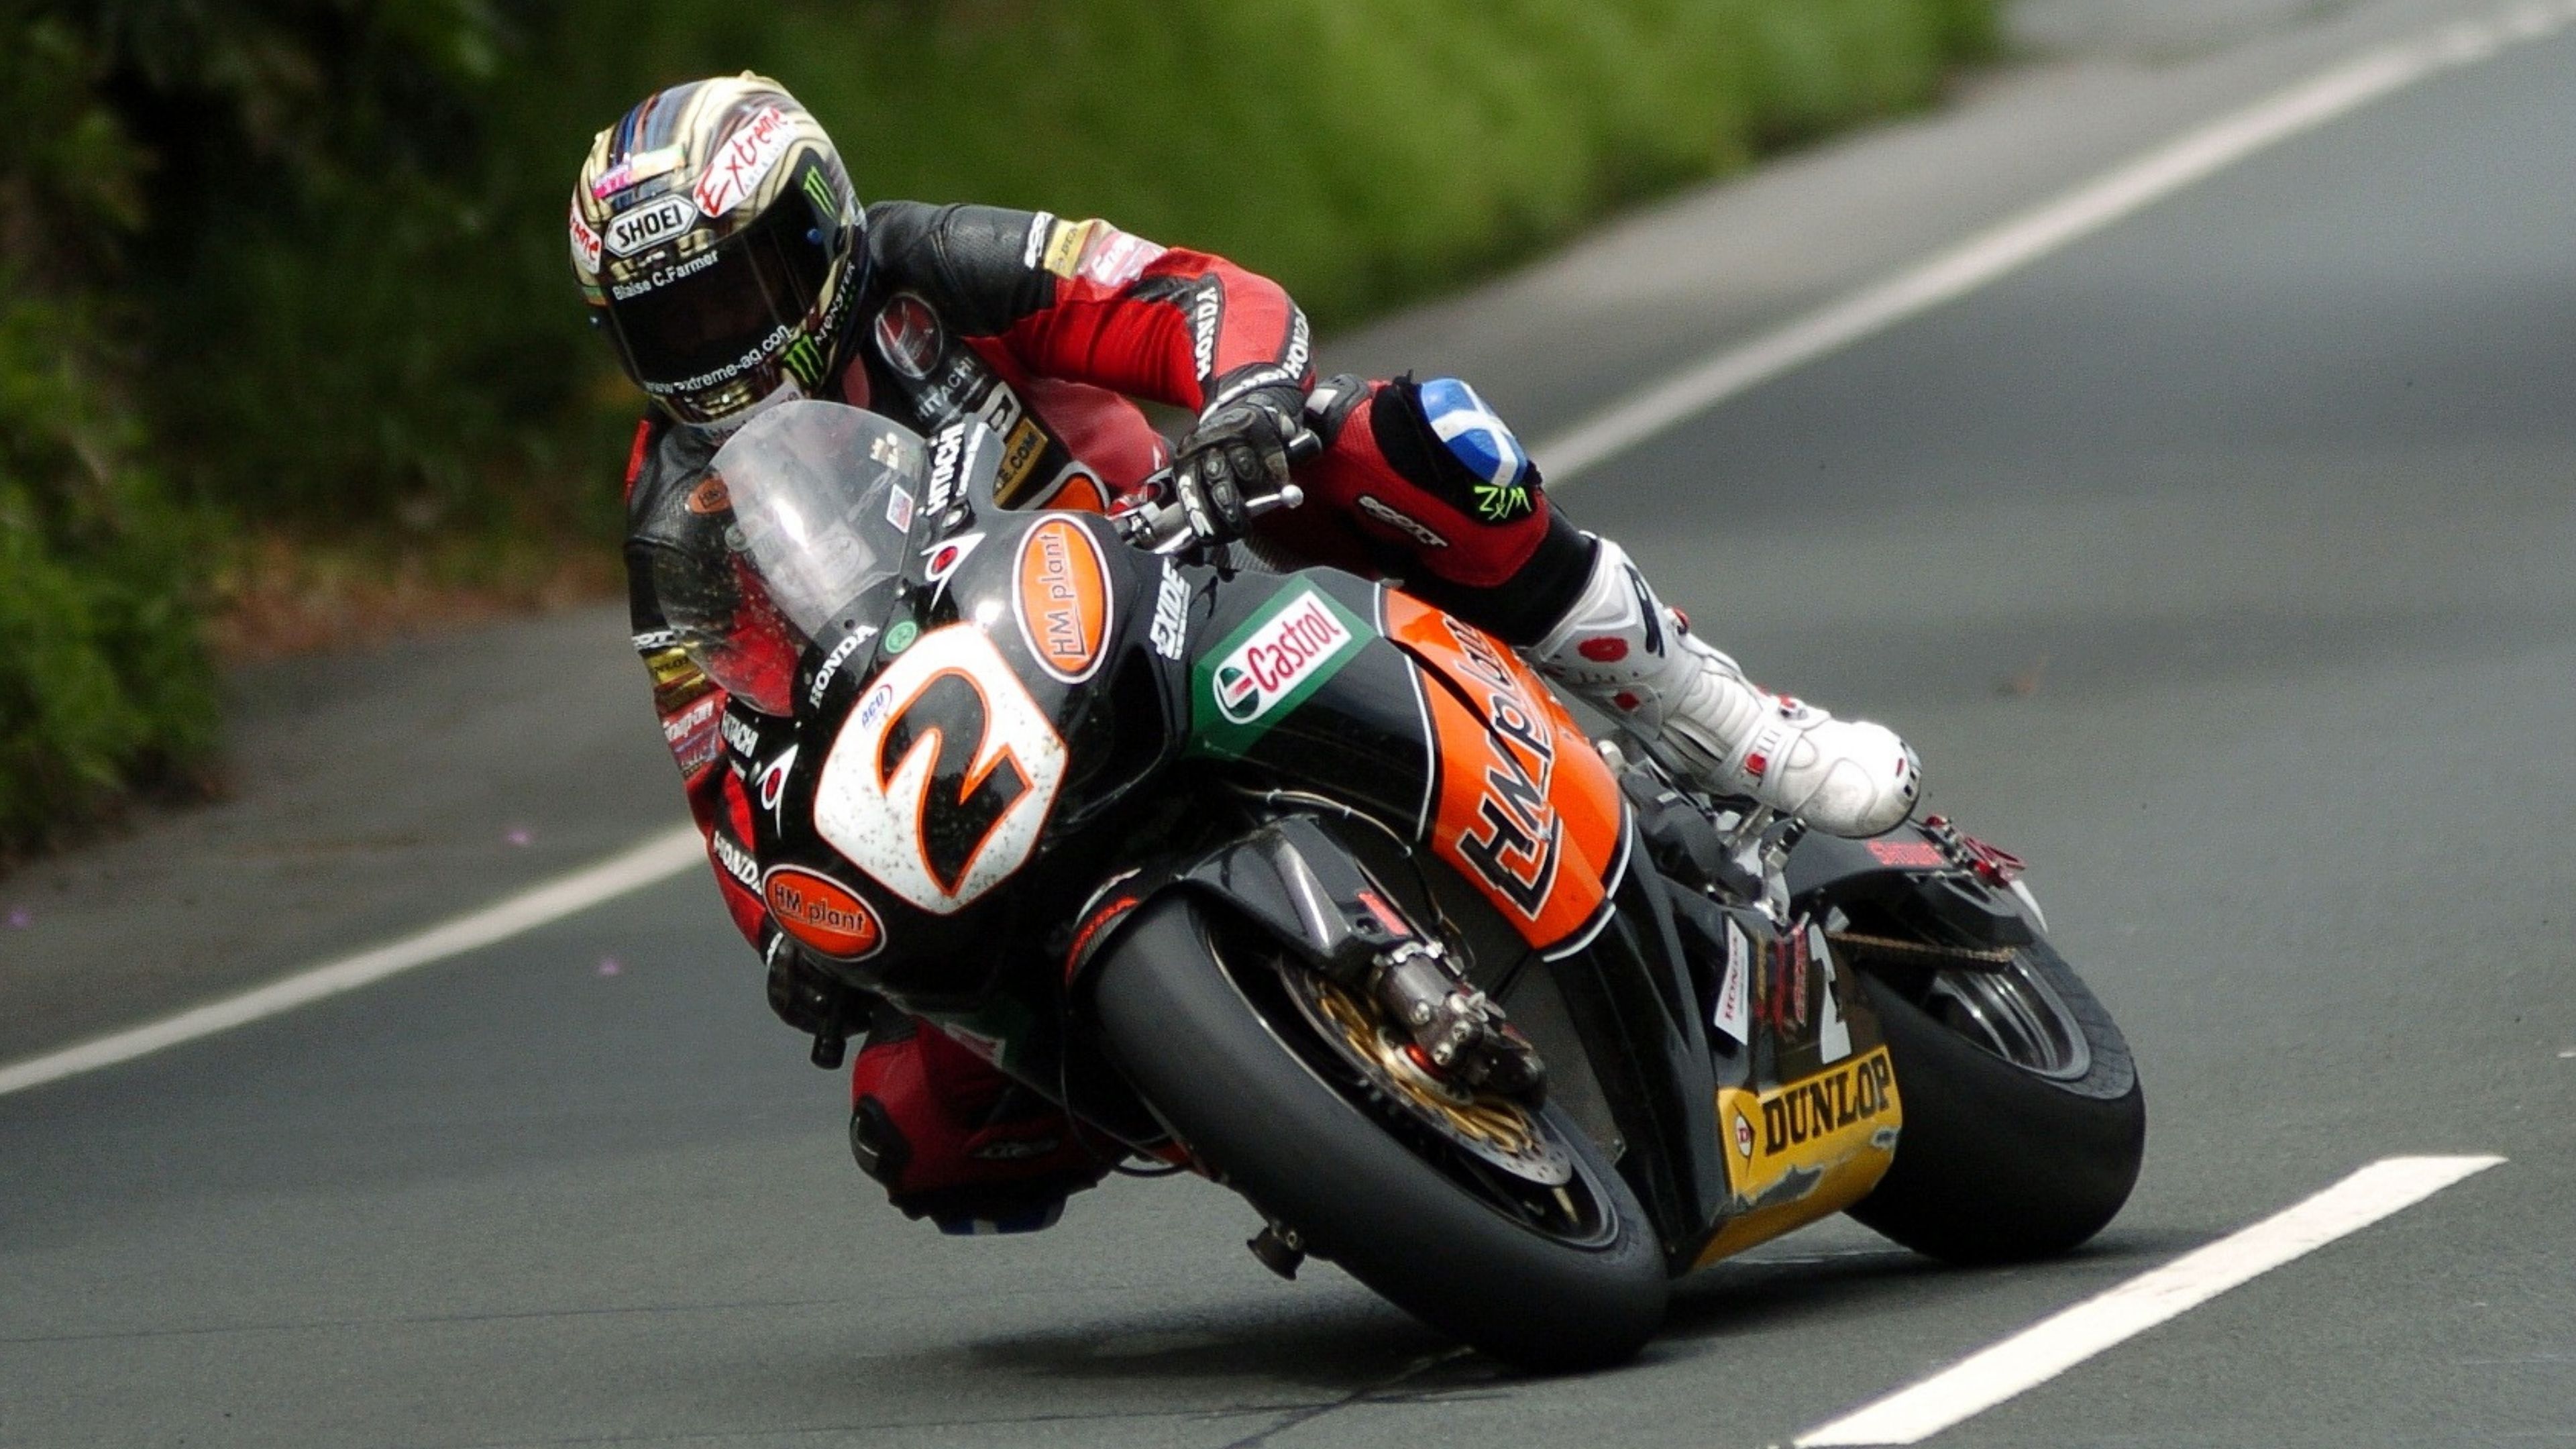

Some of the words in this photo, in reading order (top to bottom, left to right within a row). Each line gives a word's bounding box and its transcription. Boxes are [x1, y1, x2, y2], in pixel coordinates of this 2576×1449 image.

[695, 107, 788, 216] Extreme
[616, 204, 683, 248] SHOEI
[1195, 286, 1218, 382] HONDA
[926, 423, 967, 517] HITACHI
[1040, 534, 1075, 599] plant
[1149, 556, 1186, 659] EXIDE
[808, 625, 879, 710] HONDA
[1047, 610, 1078, 656] HM
[1247, 602, 1341, 694] Castrol
[875, 666, 1034, 898] 2
[1454, 729, 1562, 920] HM
[773, 882, 800, 911] HM
[809, 900, 864, 926] plant
[1762, 1053, 1890, 1157] DUNLOP
